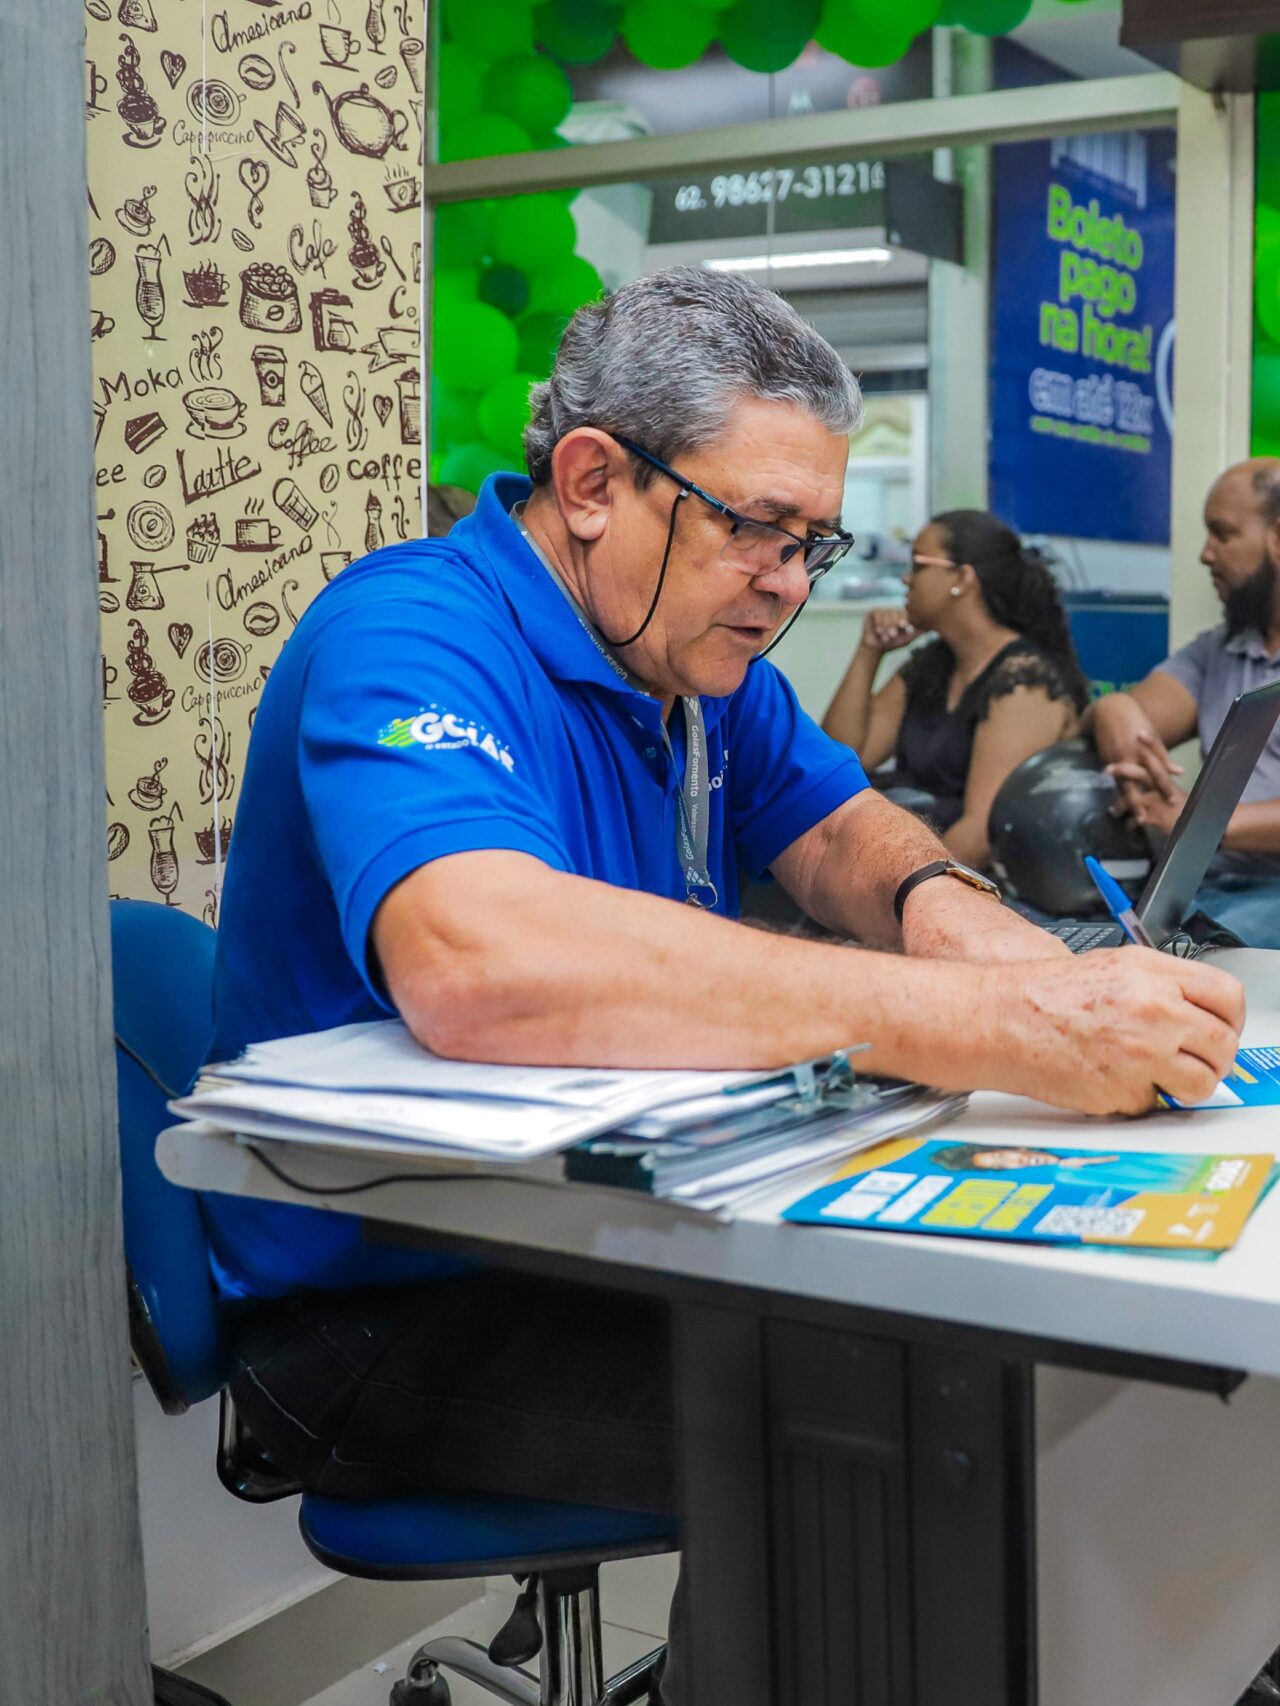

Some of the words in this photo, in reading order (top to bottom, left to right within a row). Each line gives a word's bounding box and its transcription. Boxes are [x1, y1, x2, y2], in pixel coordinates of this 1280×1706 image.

[1047, 183, 1144, 271] Boleto
[1060, 250, 1137, 317] pago
[1039, 301, 1079, 354] na
[1082, 302, 1152, 373] hora!
[100, 366, 184, 405] Moka
[268, 417, 338, 470] Coffee
